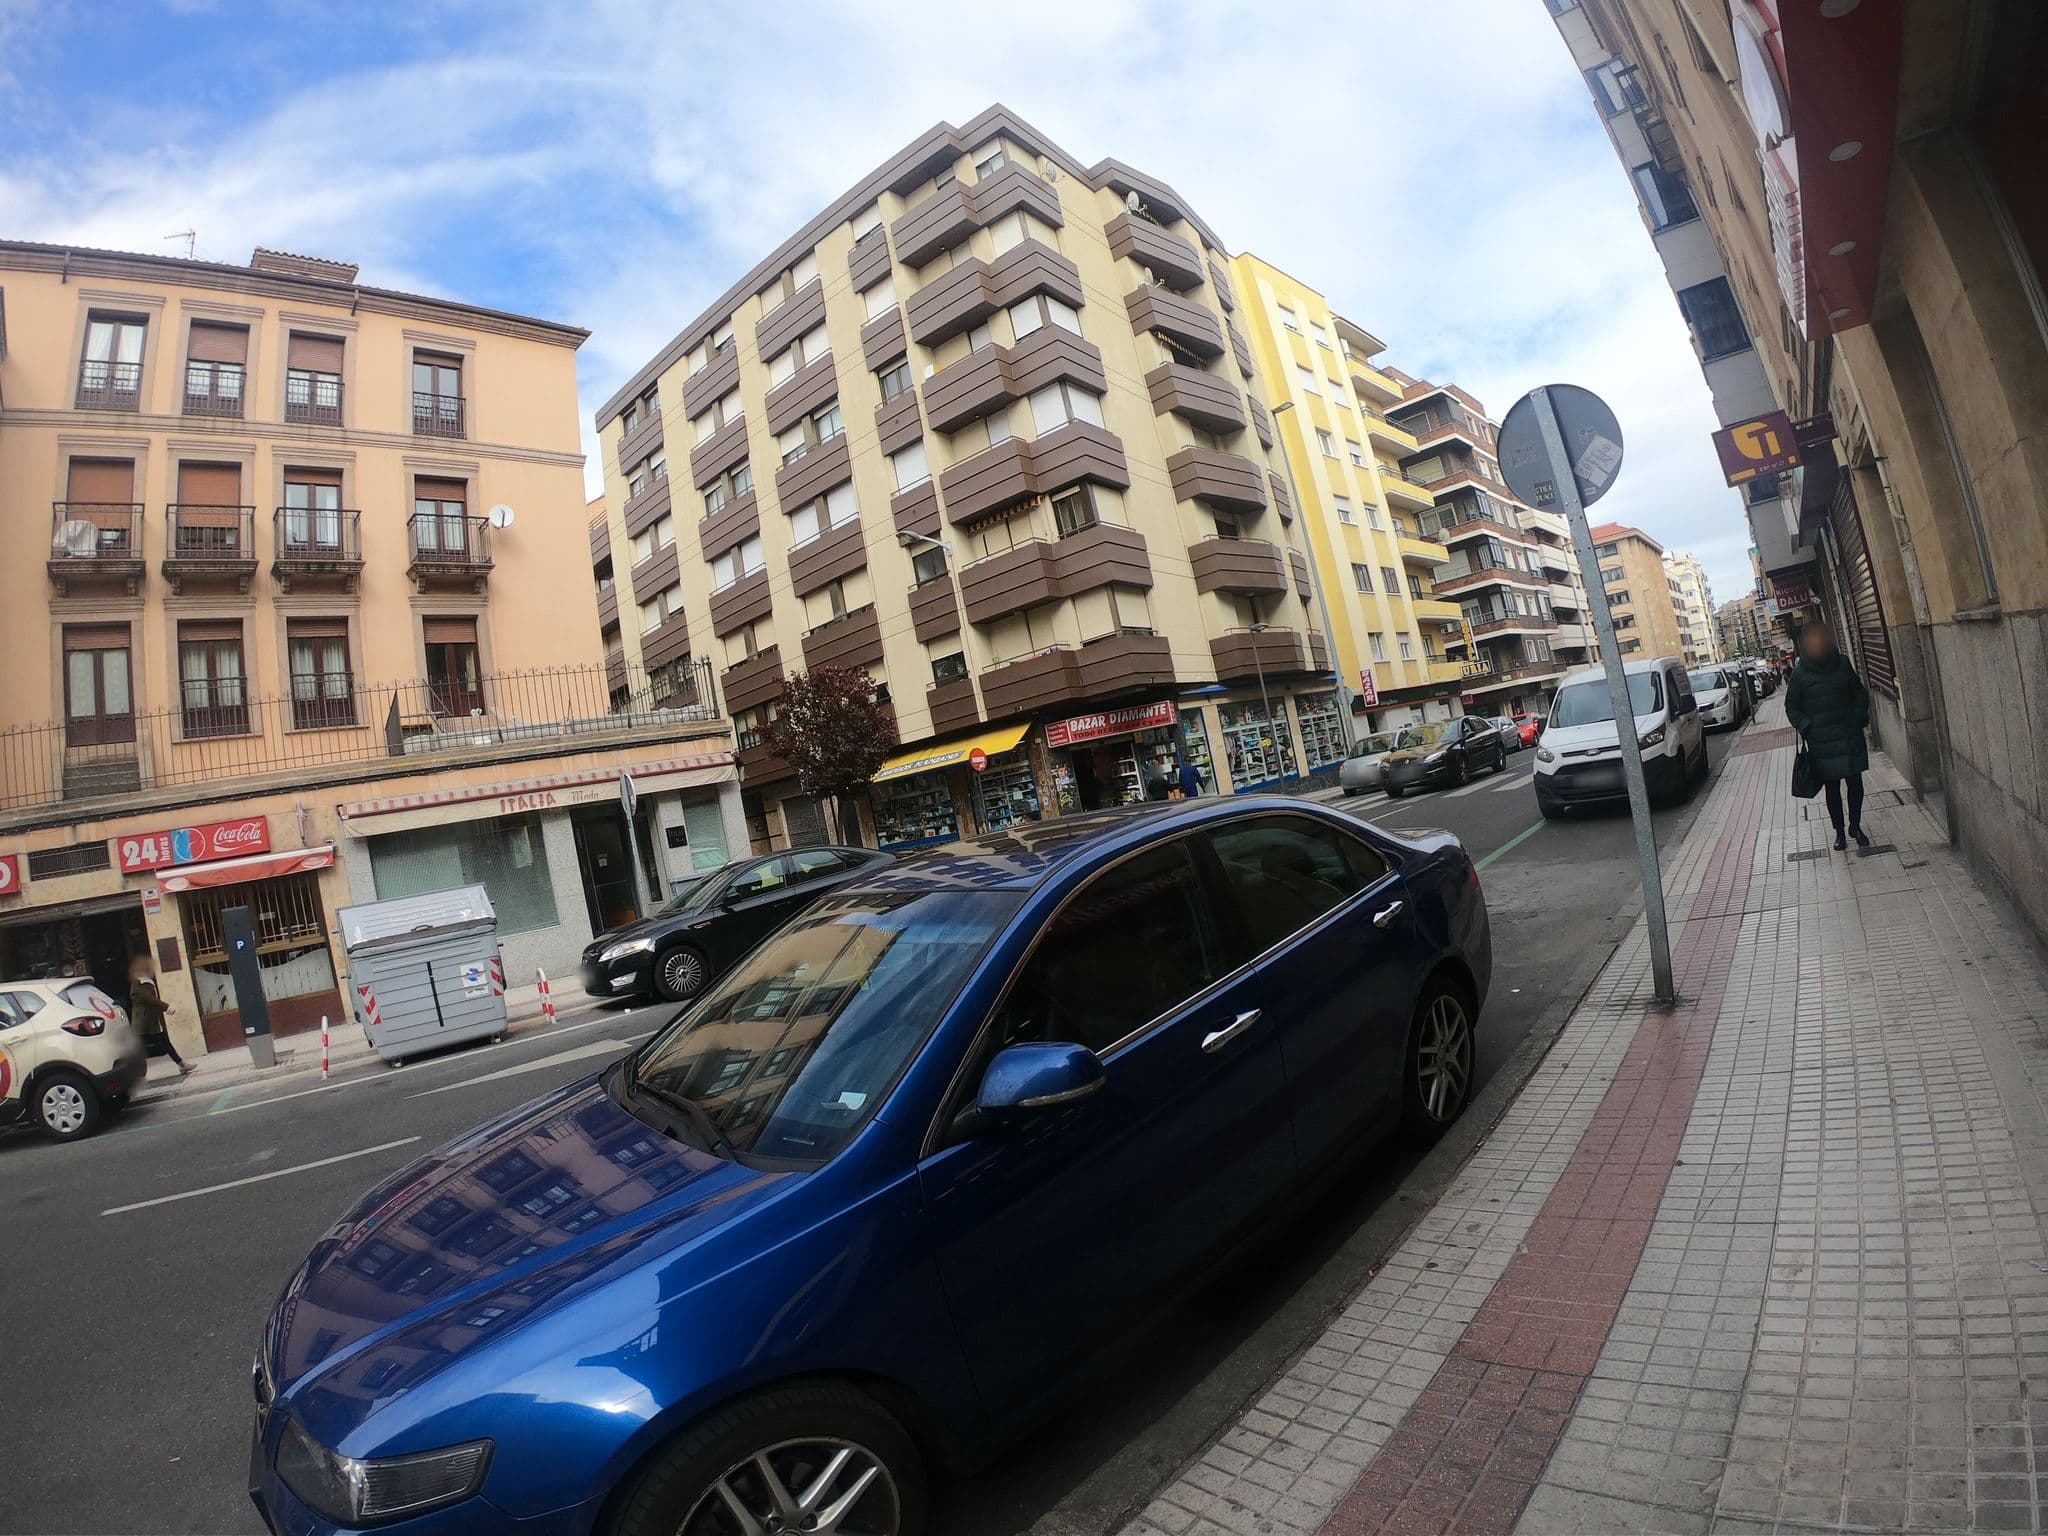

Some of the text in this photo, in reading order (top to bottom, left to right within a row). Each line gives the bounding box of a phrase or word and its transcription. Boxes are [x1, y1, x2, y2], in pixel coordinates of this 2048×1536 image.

[1780, 593, 1808, 607] DALU
[1070, 715, 1106, 732] BAZAR
[1109, 703, 1167, 725] DIAMANTE
[500, 793, 556, 813] ITALIA
[123, 838, 158, 867] 24
[160, 836, 171, 861] horas
[237, 940, 244, 949] P
